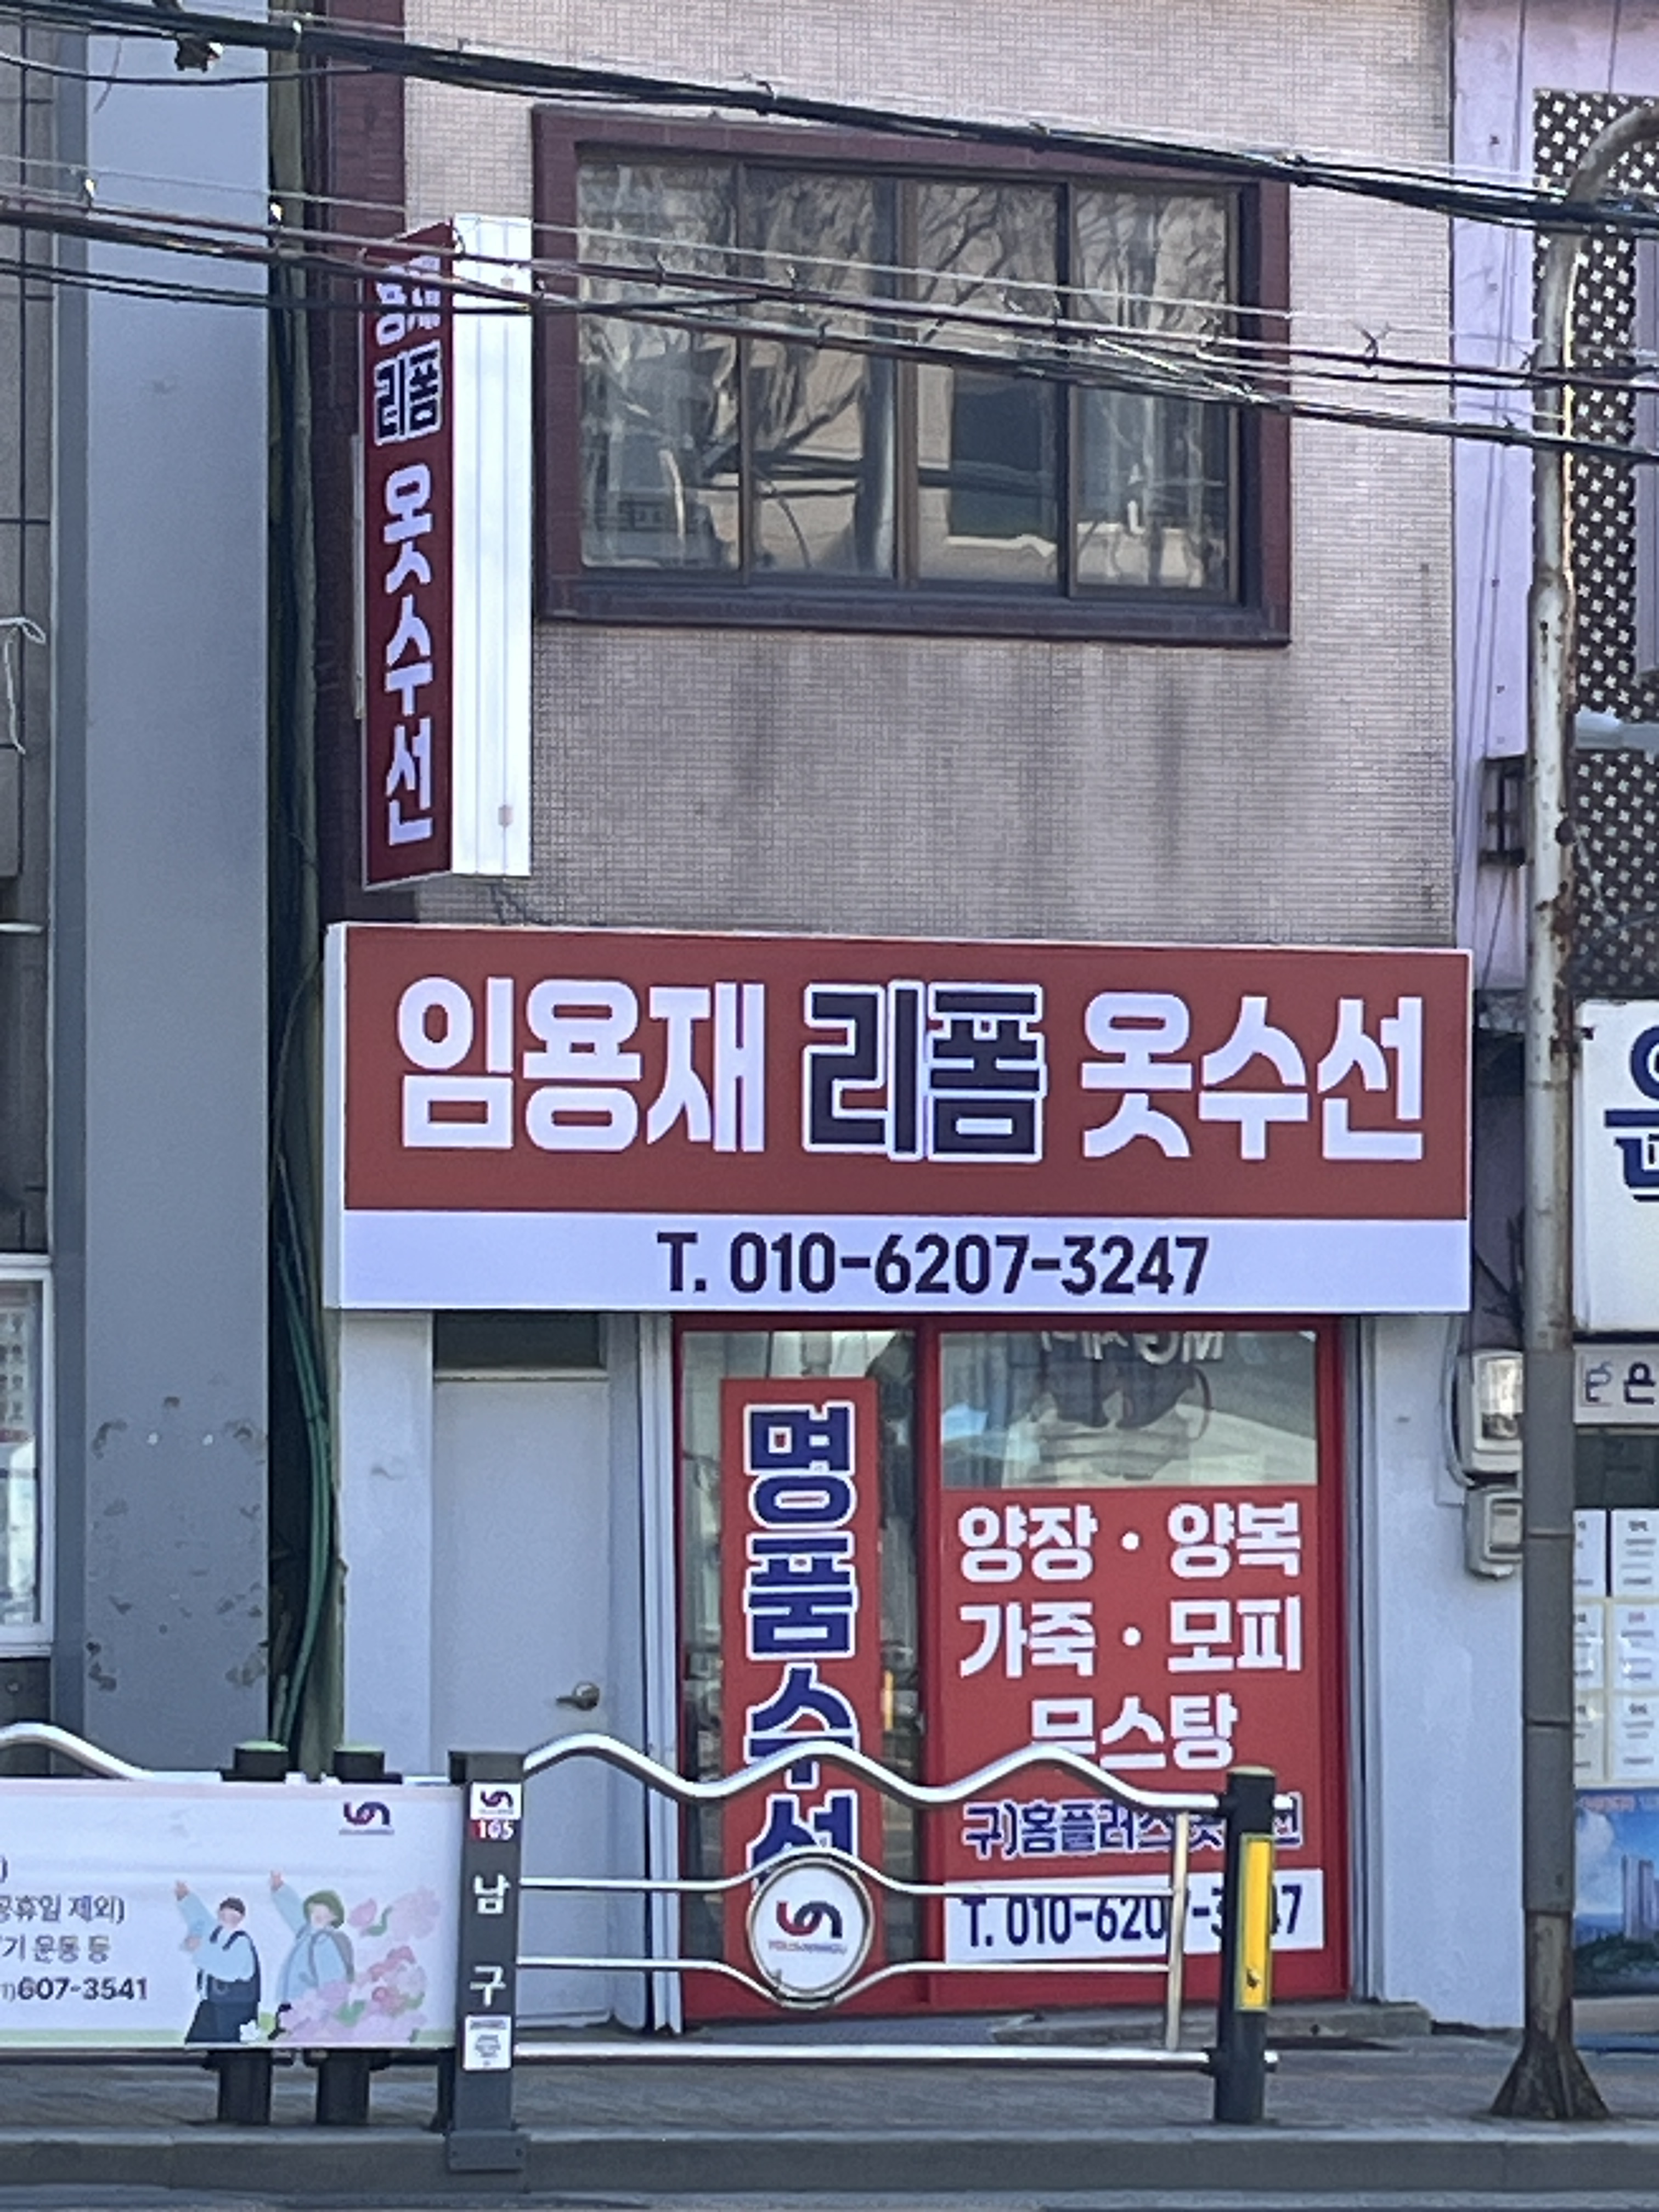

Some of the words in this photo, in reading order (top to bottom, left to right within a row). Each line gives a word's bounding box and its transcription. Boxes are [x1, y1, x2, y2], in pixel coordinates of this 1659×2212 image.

[374, 339, 442, 447] 리폼
[383, 462, 432, 846] 옷수선
[397, 976, 765, 1152] 임용재
[801, 979, 1048, 1163] 리폼
[1081, 991, 1423, 1160] 옷수선
[656, 1232, 707, 1292] T.
[729, 1232, 1209, 1295] 010-6207-3247
[958, 1505, 1098, 1582] 양장
[1167, 1502, 1301, 1579] 양복
[960, 1601, 1096, 1679] 가죽
[1167, 1595, 1301, 1673] 모피
[68, 1894, 125, 1925] 제외)
[475, 1874, 511, 1914] 남
[0, 1934, 26, 1963] 기
[33, 1934, 80, 1964] 운동
[87, 1935, 111, 1964] 등
[470, 1965, 507, 2007] 구
